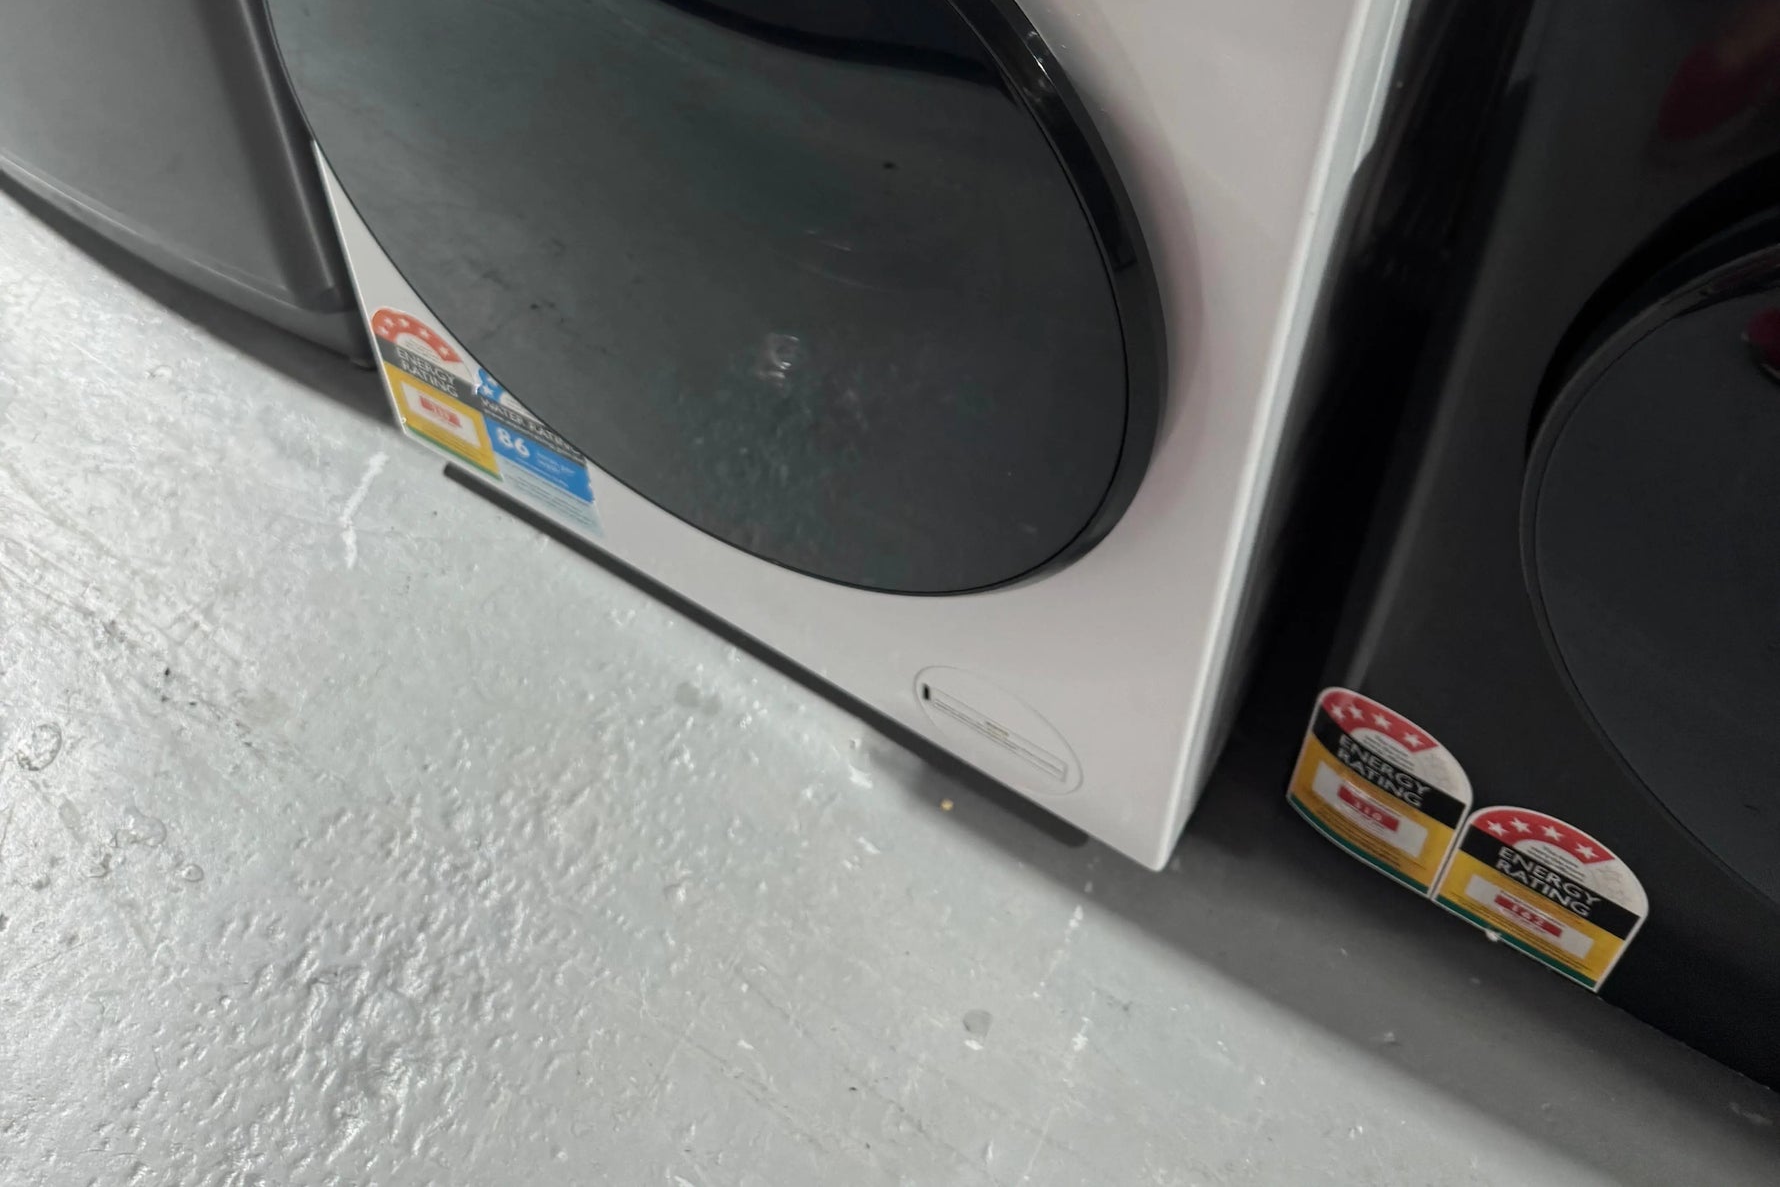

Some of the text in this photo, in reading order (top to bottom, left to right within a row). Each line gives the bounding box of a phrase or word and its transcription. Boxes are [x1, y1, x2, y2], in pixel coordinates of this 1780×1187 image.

[397, 348, 458, 387] ENERGY
[401, 361, 459, 398] RATING
[496, 427, 530, 458] 86
[1337, 745, 1424, 807] RATING
[1339, 734, 1431, 795] ENERGY
[1496, 859, 1592, 917] RATING
[1499, 846, 1601, 905] ENERGY
